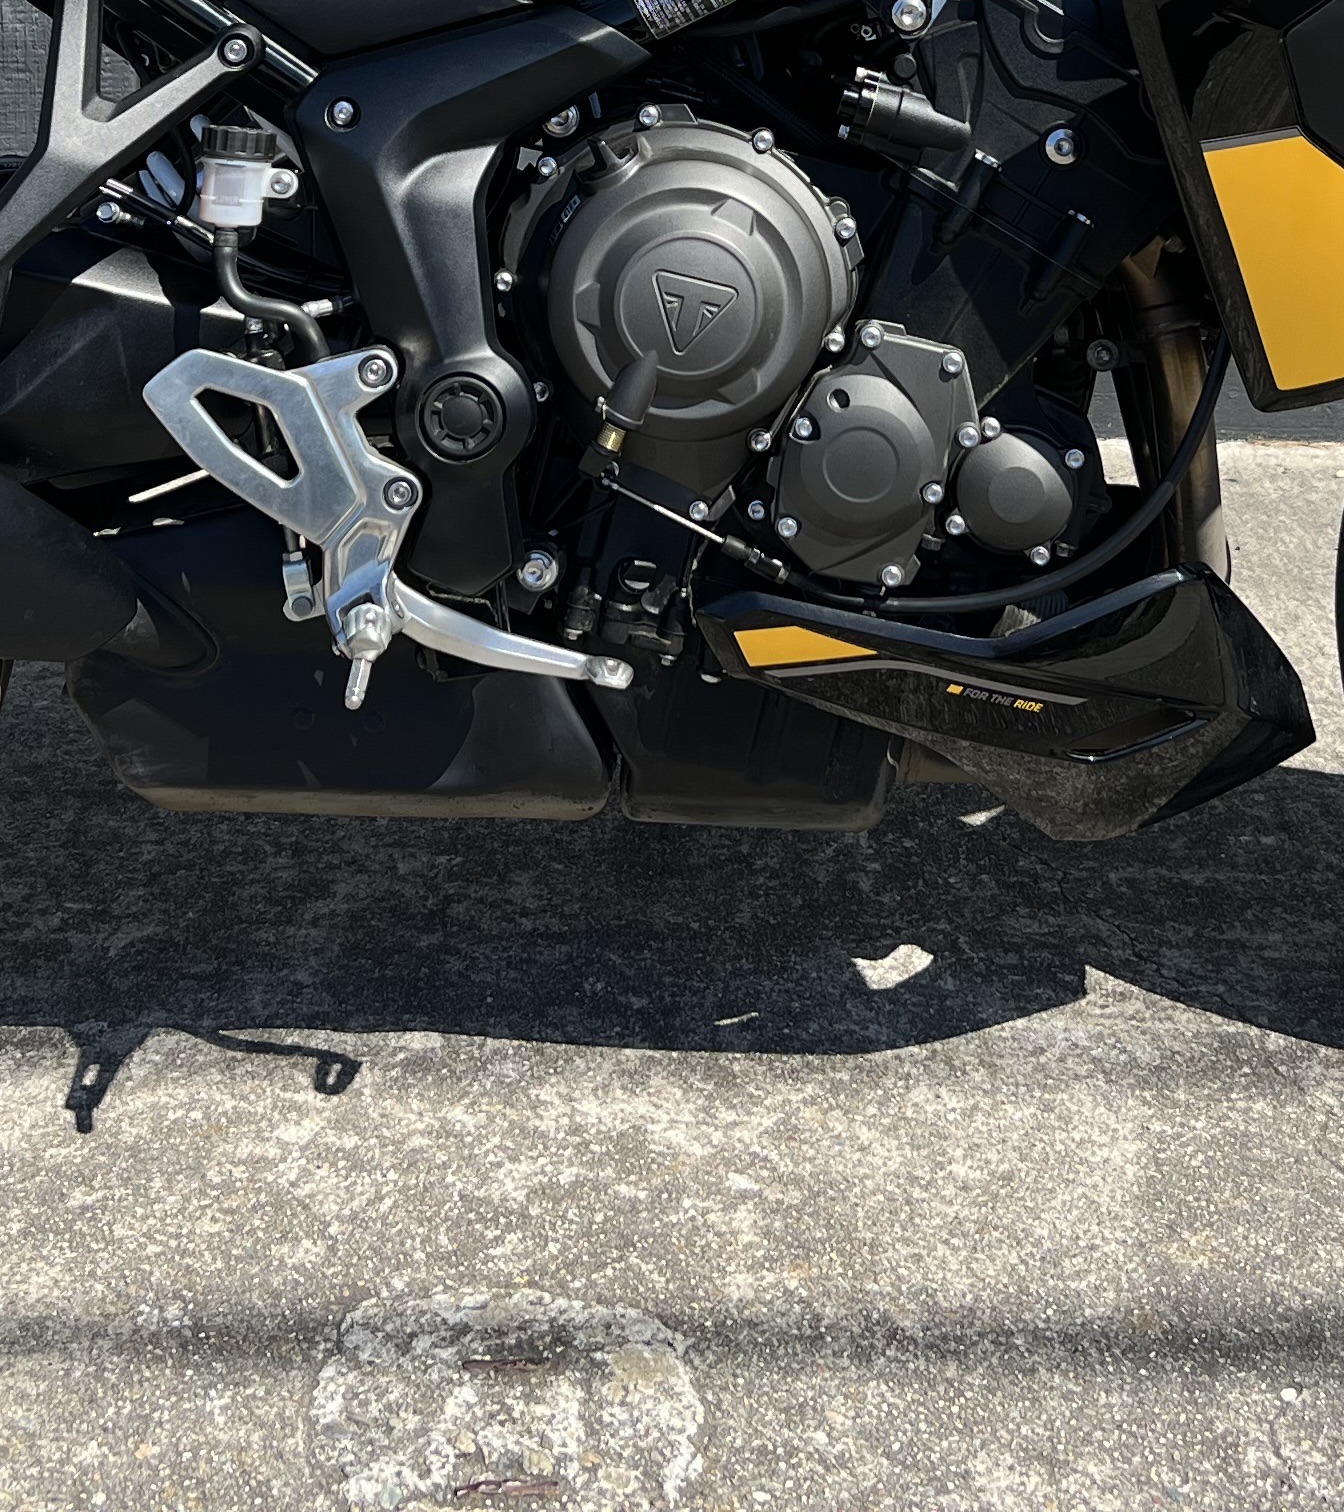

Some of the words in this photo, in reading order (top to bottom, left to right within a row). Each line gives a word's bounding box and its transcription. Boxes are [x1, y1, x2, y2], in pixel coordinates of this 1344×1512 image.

[962, 687, 989, 702] FOR
[989, 694, 1014, 706] THE
[1013, 698, 1044, 713] RIDE
